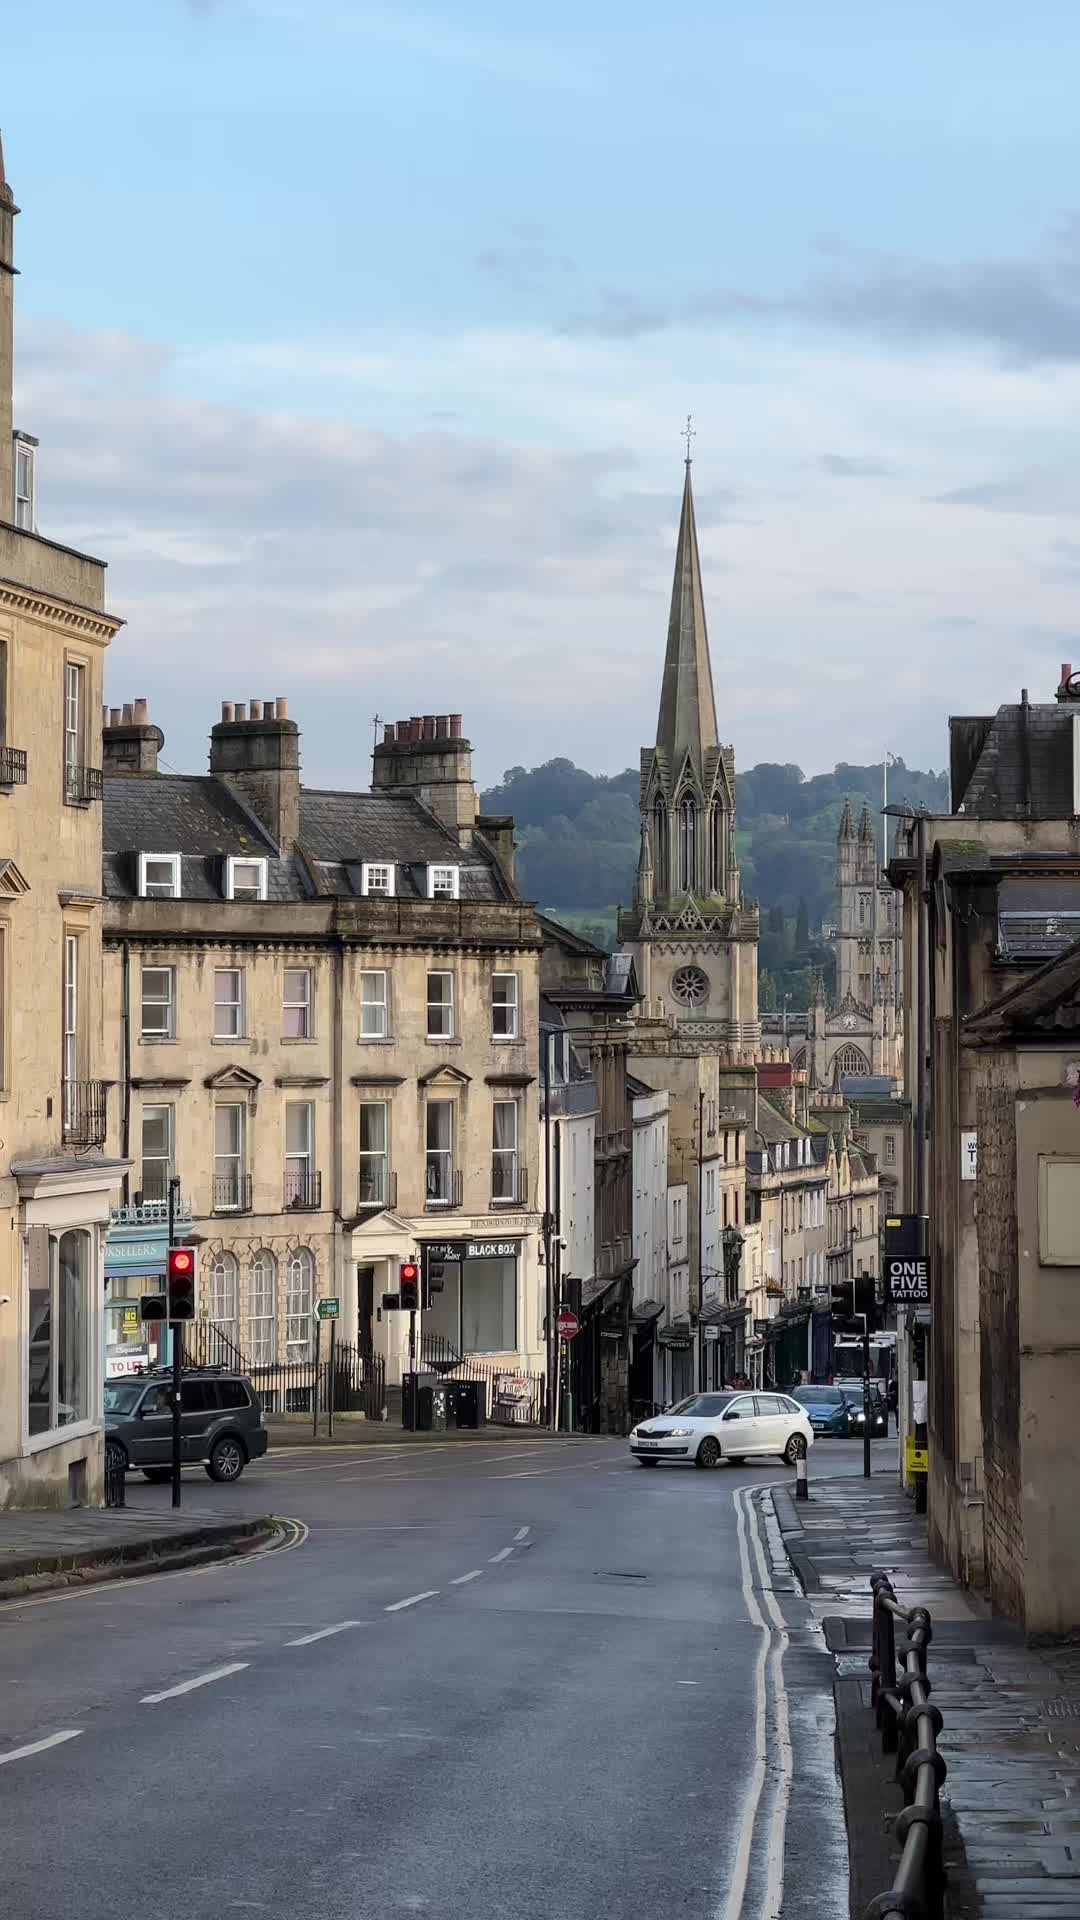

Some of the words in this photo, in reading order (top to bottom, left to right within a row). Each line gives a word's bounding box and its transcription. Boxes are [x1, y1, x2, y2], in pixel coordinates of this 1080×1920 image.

[468, 1243, 497, 1256] BLACK
[498, 1243, 516, 1254] BOX
[890, 1262, 927, 1275] ONE
[890, 1275, 928, 1289] FIVE
[891, 1290, 928, 1298] TATTOO
[110, 1362, 124, 1372] TO
